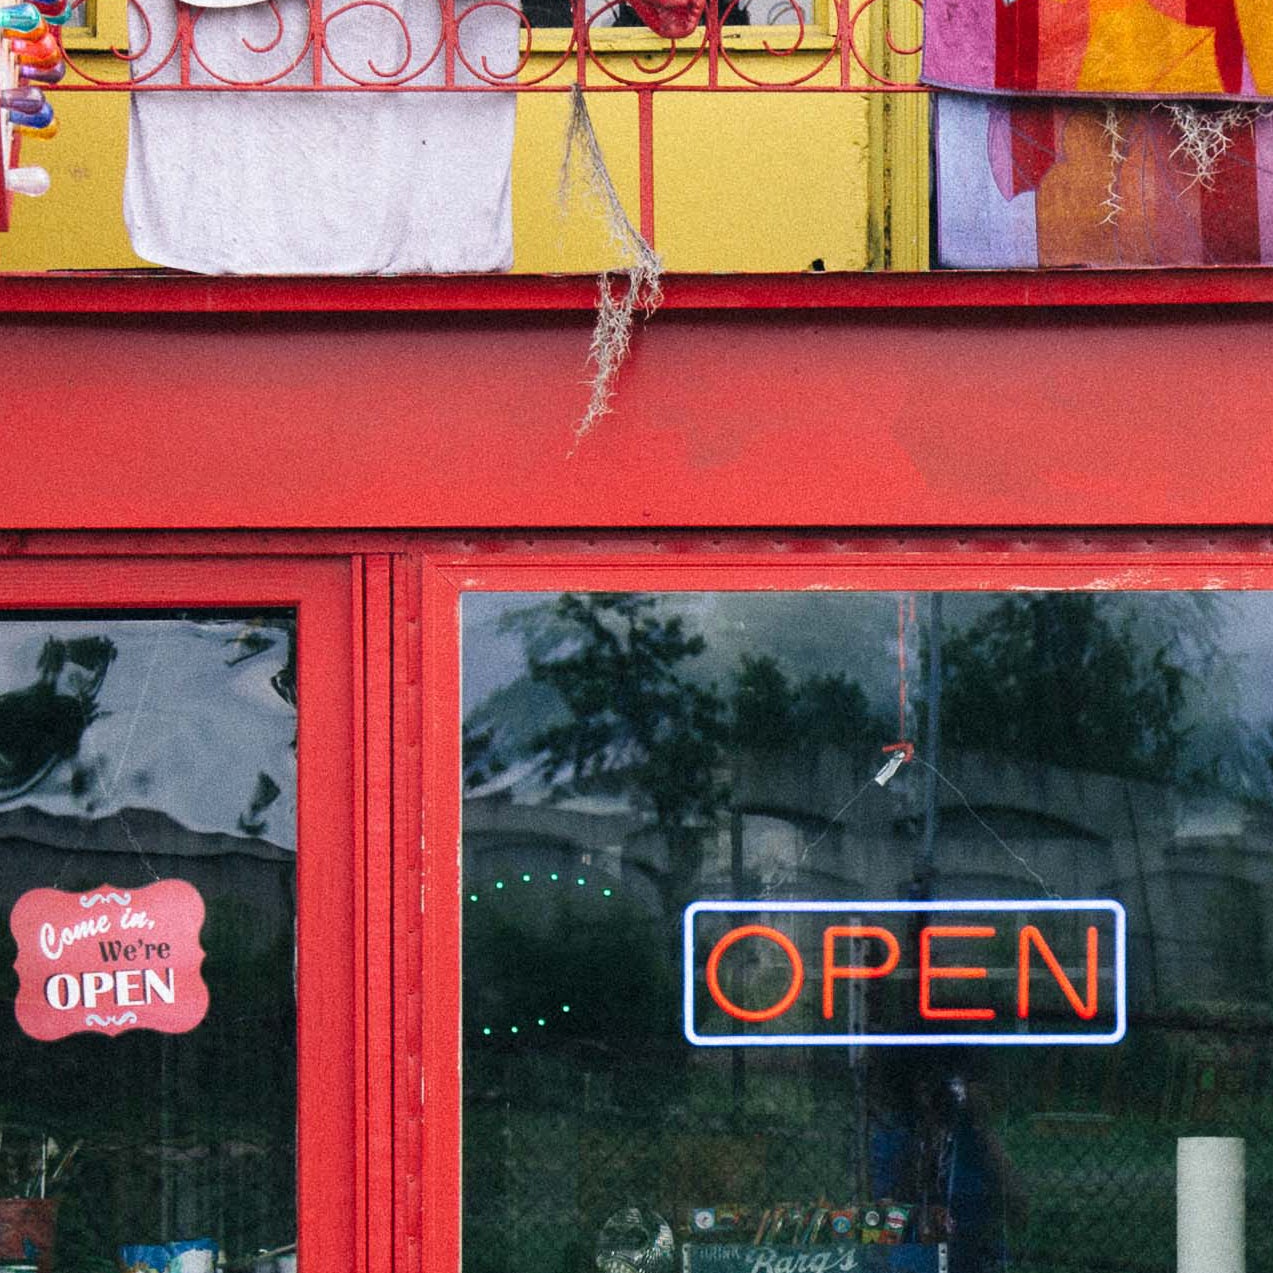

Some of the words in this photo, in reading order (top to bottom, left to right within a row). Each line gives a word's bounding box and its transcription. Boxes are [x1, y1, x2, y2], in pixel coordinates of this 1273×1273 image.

[39, 914, 112, 961] Come
[98, 939, 171, 963] We're
[43, 967, 175, 1011] OPEN
[705, 923, 1100, 1023] OPEN
